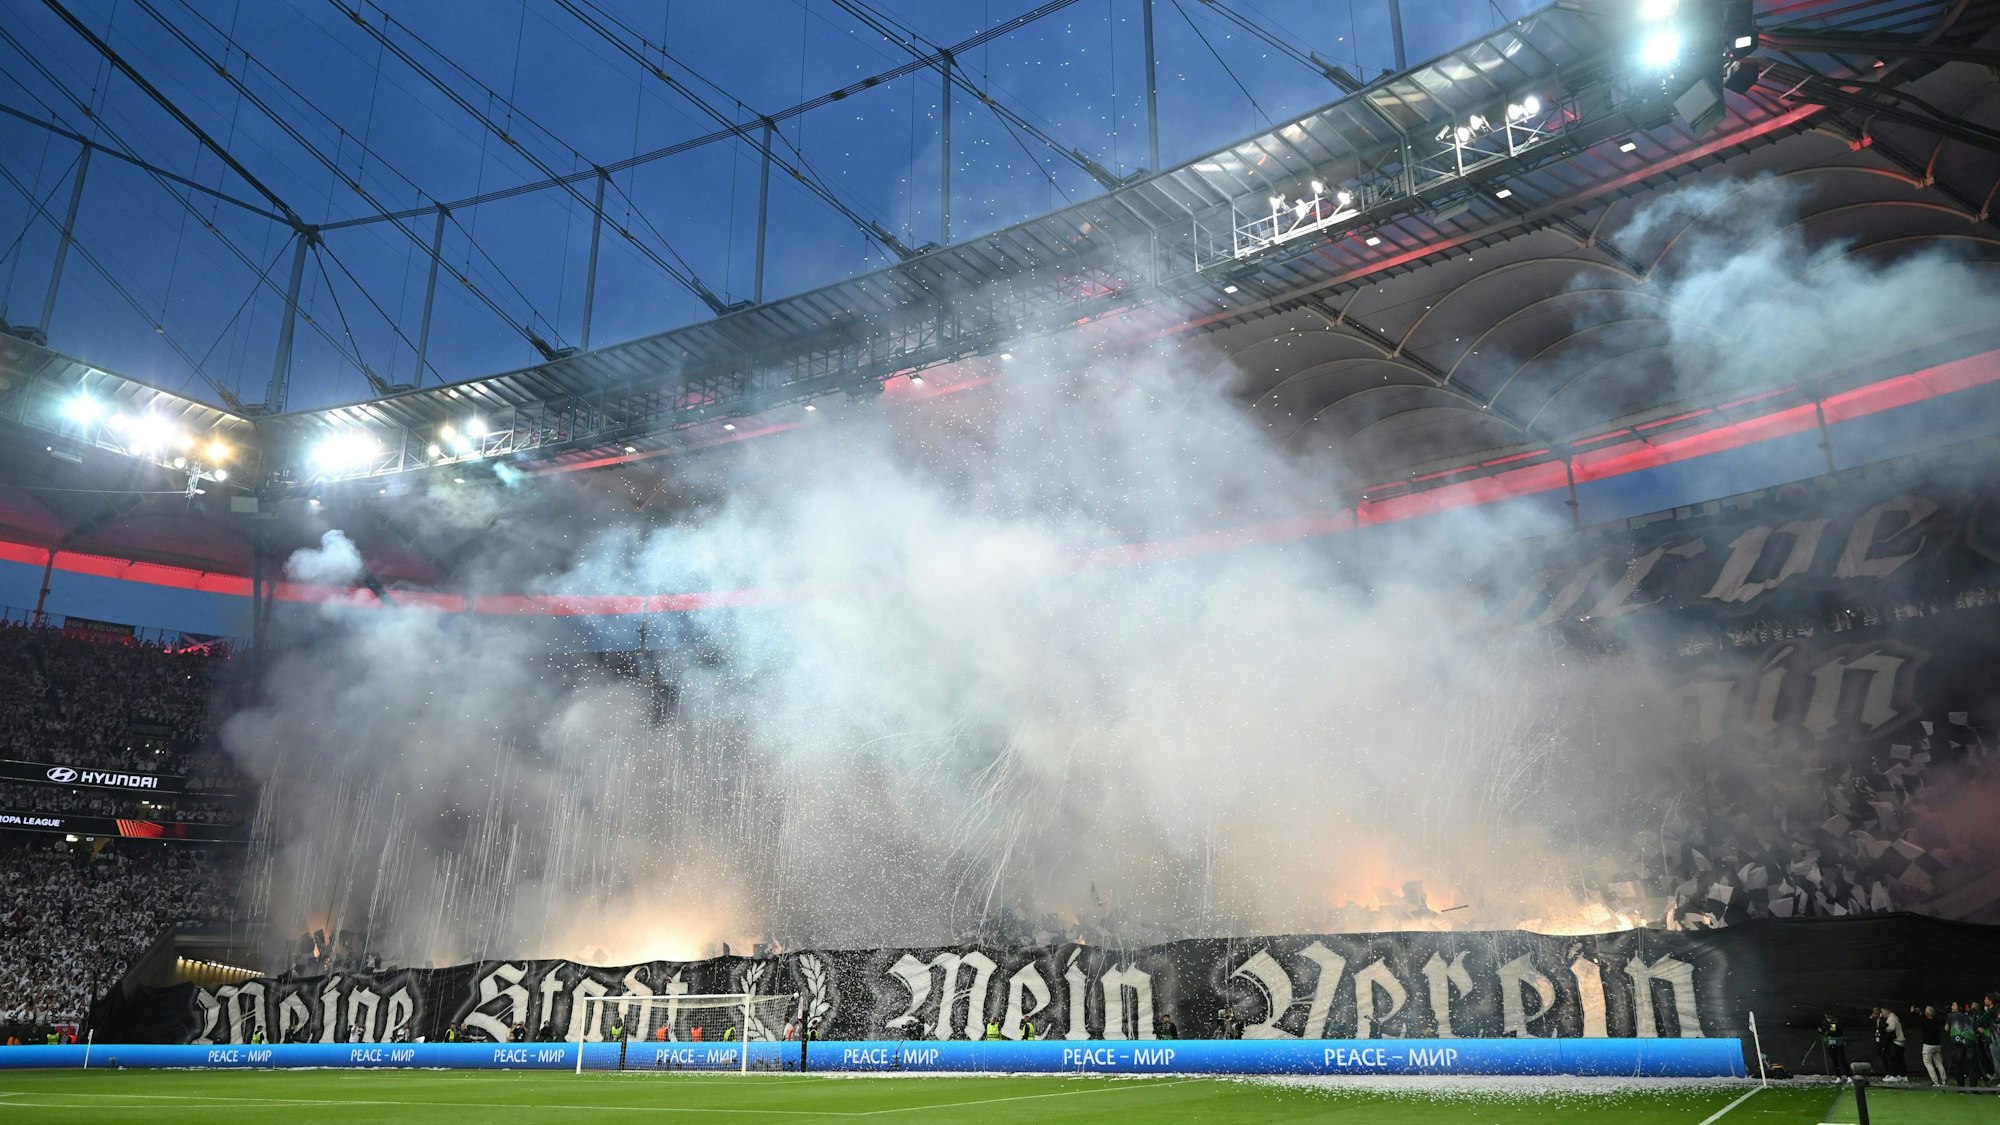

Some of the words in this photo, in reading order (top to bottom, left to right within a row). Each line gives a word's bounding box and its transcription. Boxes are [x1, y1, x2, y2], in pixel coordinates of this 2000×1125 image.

[81, 771, 158, 788] HYUNDAI
[23, 817, 60, 827] LEAGUE
[191, 976, 424, 1043] Meine
[463, 962, 688, 1042] Stadt
[886, 948, 1156, 1040] Mein
[1230, 941, 1701, 1038] Verein
[208, 1051, 239, 1062] PEACE
[247, 1050, 272, 1062] МИР
[351, 1049, 382, 1062] PEACE
[391, 1049, 415, 1062] МИР
[494, 1049, 527, 1062] PEACE
[538, 1049, 565, 1063] МИР
[656, 1049, 695, 1064] PEACE
[707, 1049, 738, 1064] МИР
[844, 1049, 888, 1064] PEACE
[903, 1049, 939, 1065] МИР
[1064, 1049, 1116, 1065] PEACE
[1134, 1049, 1176, 1065] МИР
[1324, 1048, 1388, 1067] PEACE
[1409, 1048, 1458, 1067] МИР
